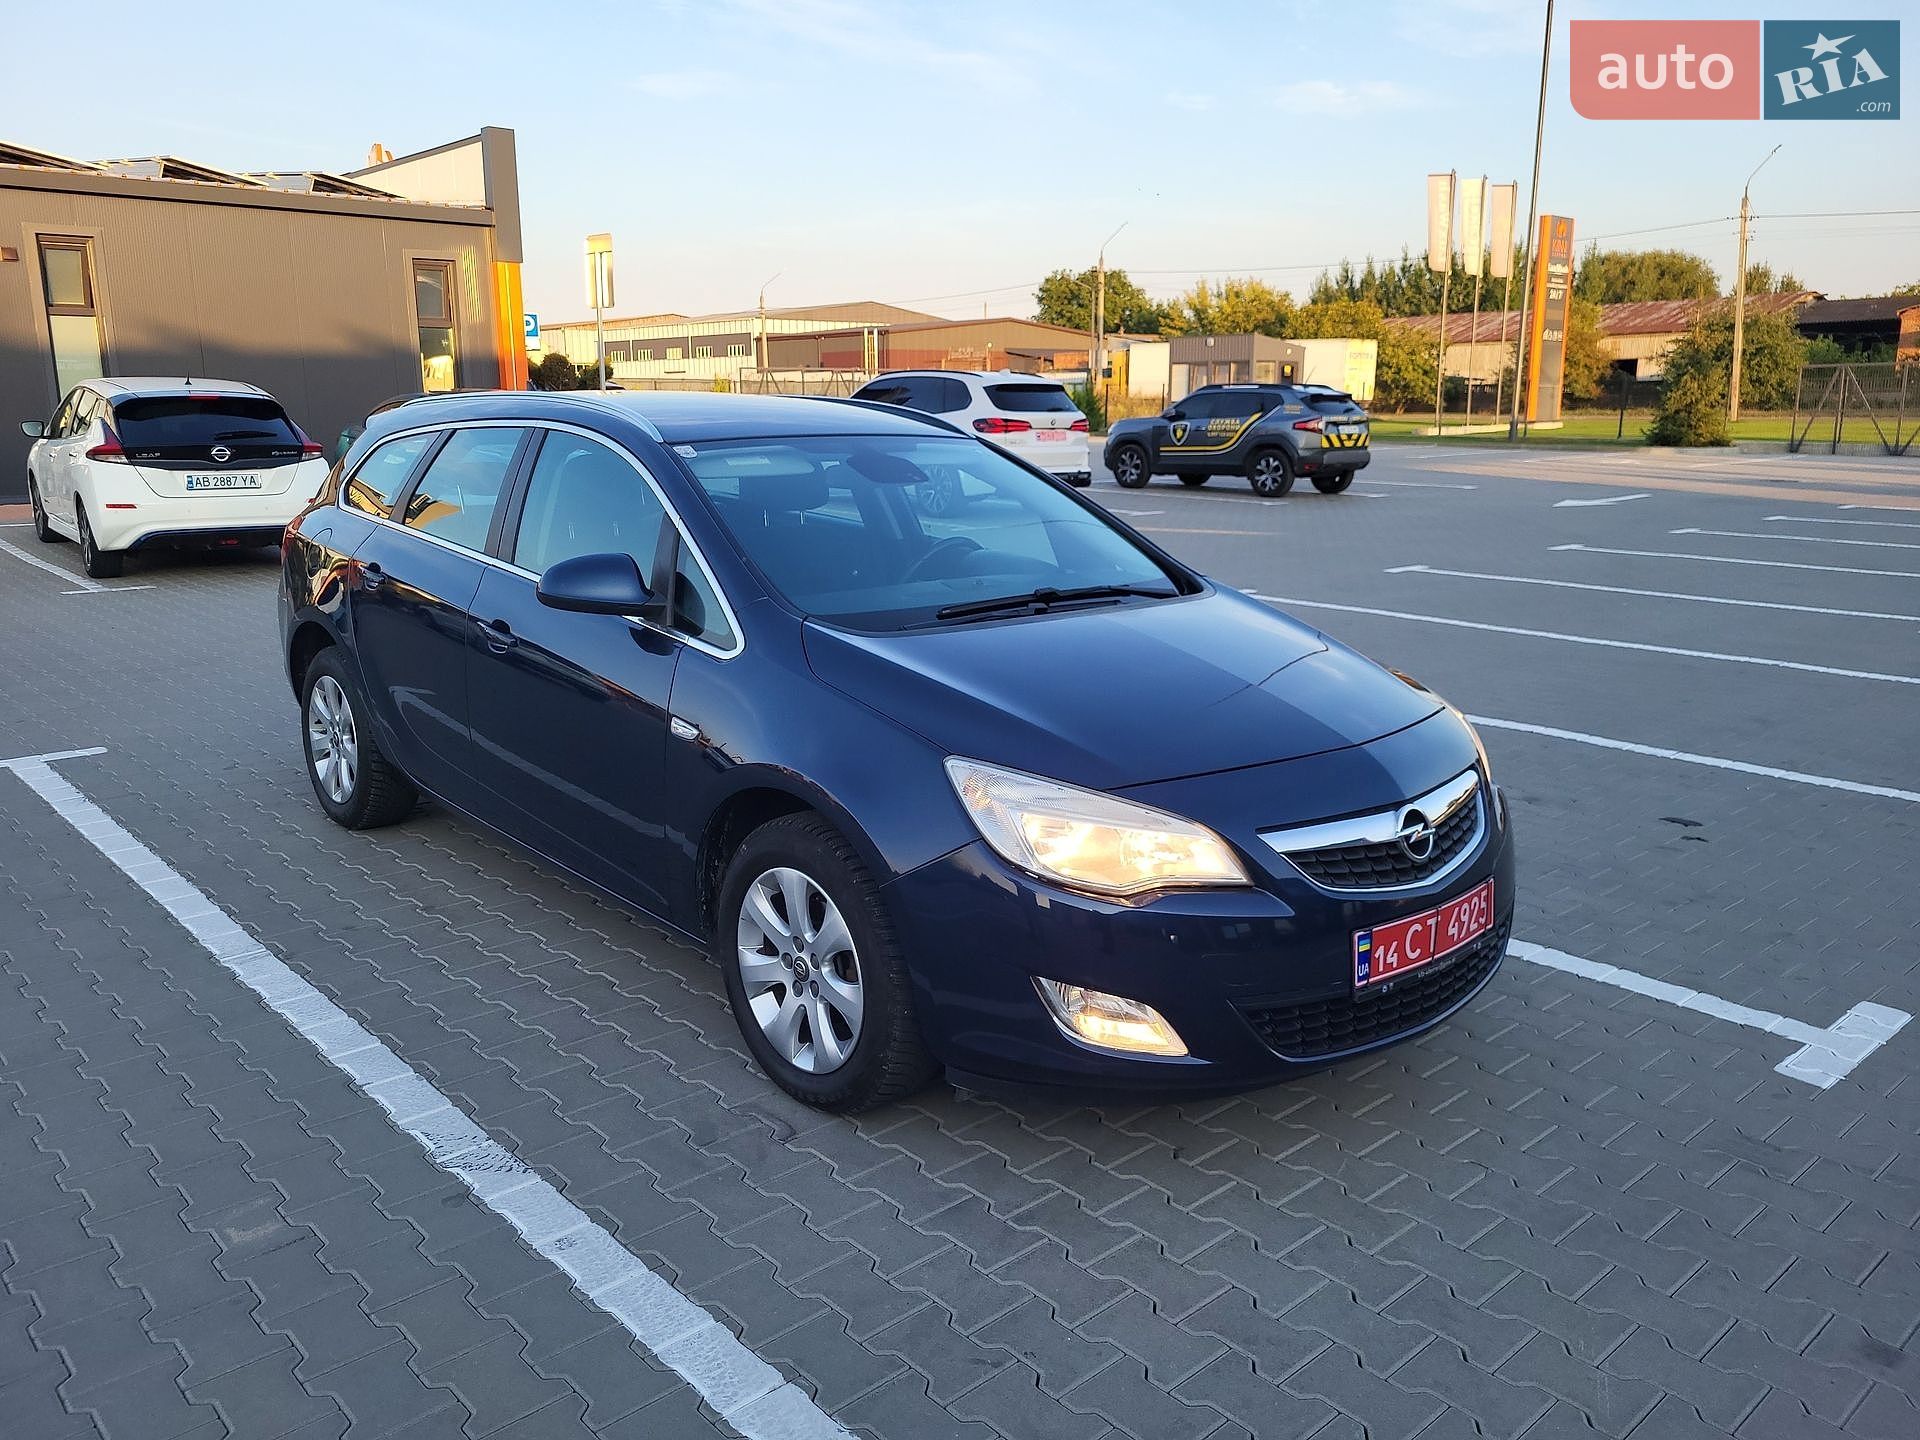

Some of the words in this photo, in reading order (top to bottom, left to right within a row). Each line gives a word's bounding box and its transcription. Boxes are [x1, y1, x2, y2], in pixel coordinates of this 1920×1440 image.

[195, 476, 210, 487] AB
[212, 476, 237, 487] 2887
[240, 475, 256, 486] YA
[1374, 941, 1398, 972] 14
[1447, 890, 1487, 941] 4925
[1358, 962, 1369, 976] UA
